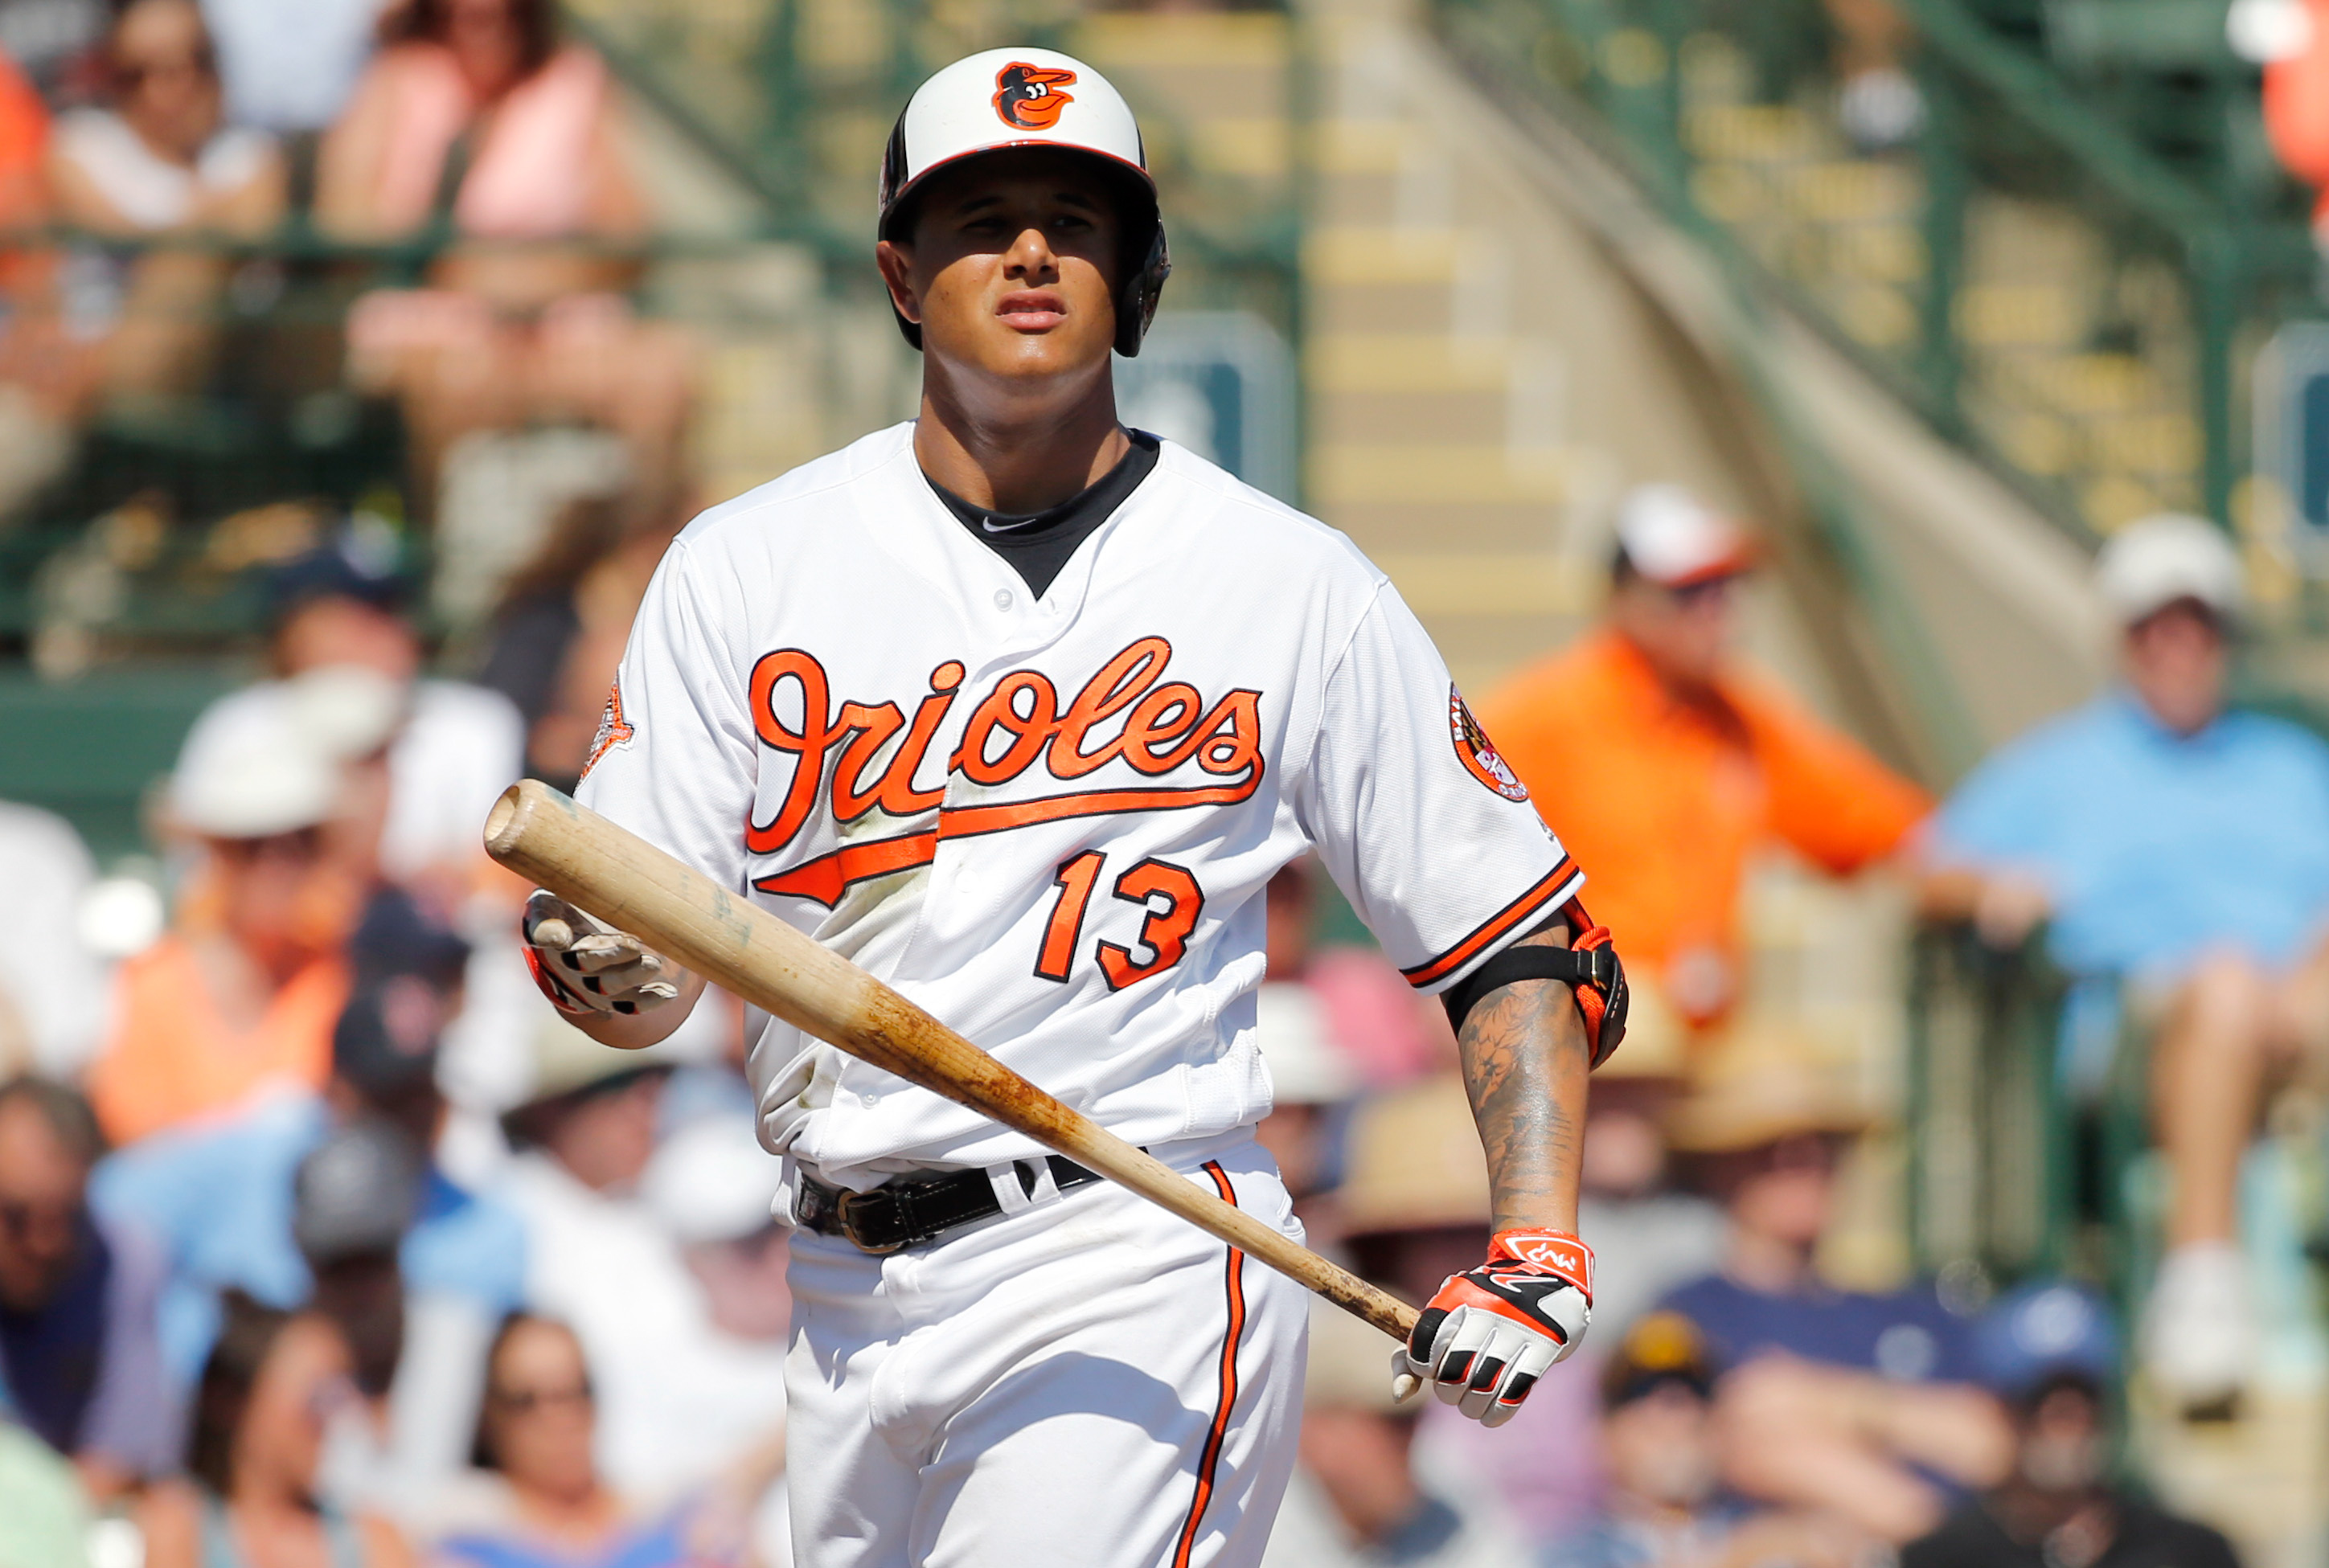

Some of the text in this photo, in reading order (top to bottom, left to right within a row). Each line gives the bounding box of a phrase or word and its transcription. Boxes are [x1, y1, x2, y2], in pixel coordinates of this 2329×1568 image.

[748, 636, 1265, 855] Orioles
[1034, 849, 1205, 993] 13
[1527, 1242, 1577, 1271] MVP
